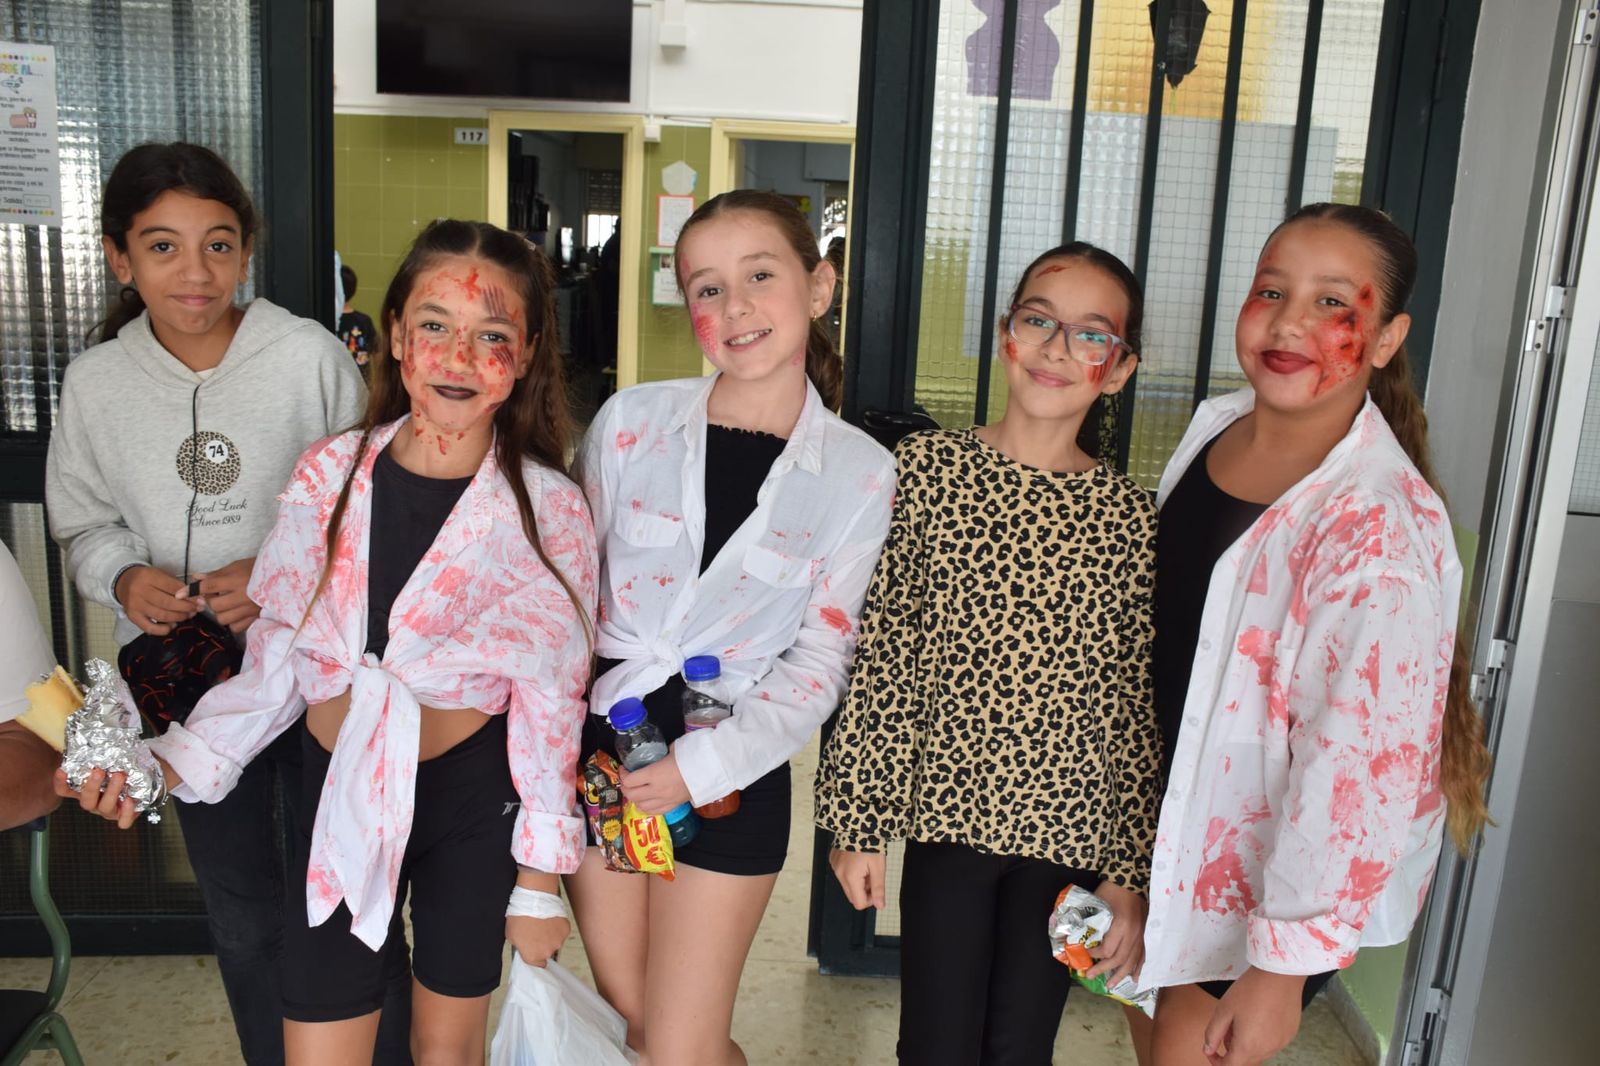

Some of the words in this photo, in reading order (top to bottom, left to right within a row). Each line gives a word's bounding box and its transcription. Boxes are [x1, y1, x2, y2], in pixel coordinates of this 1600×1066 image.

[462, 131, 483, 141] 117
[209, 444, 225, 458] 74
[219, 498, 248, 511] Luck
